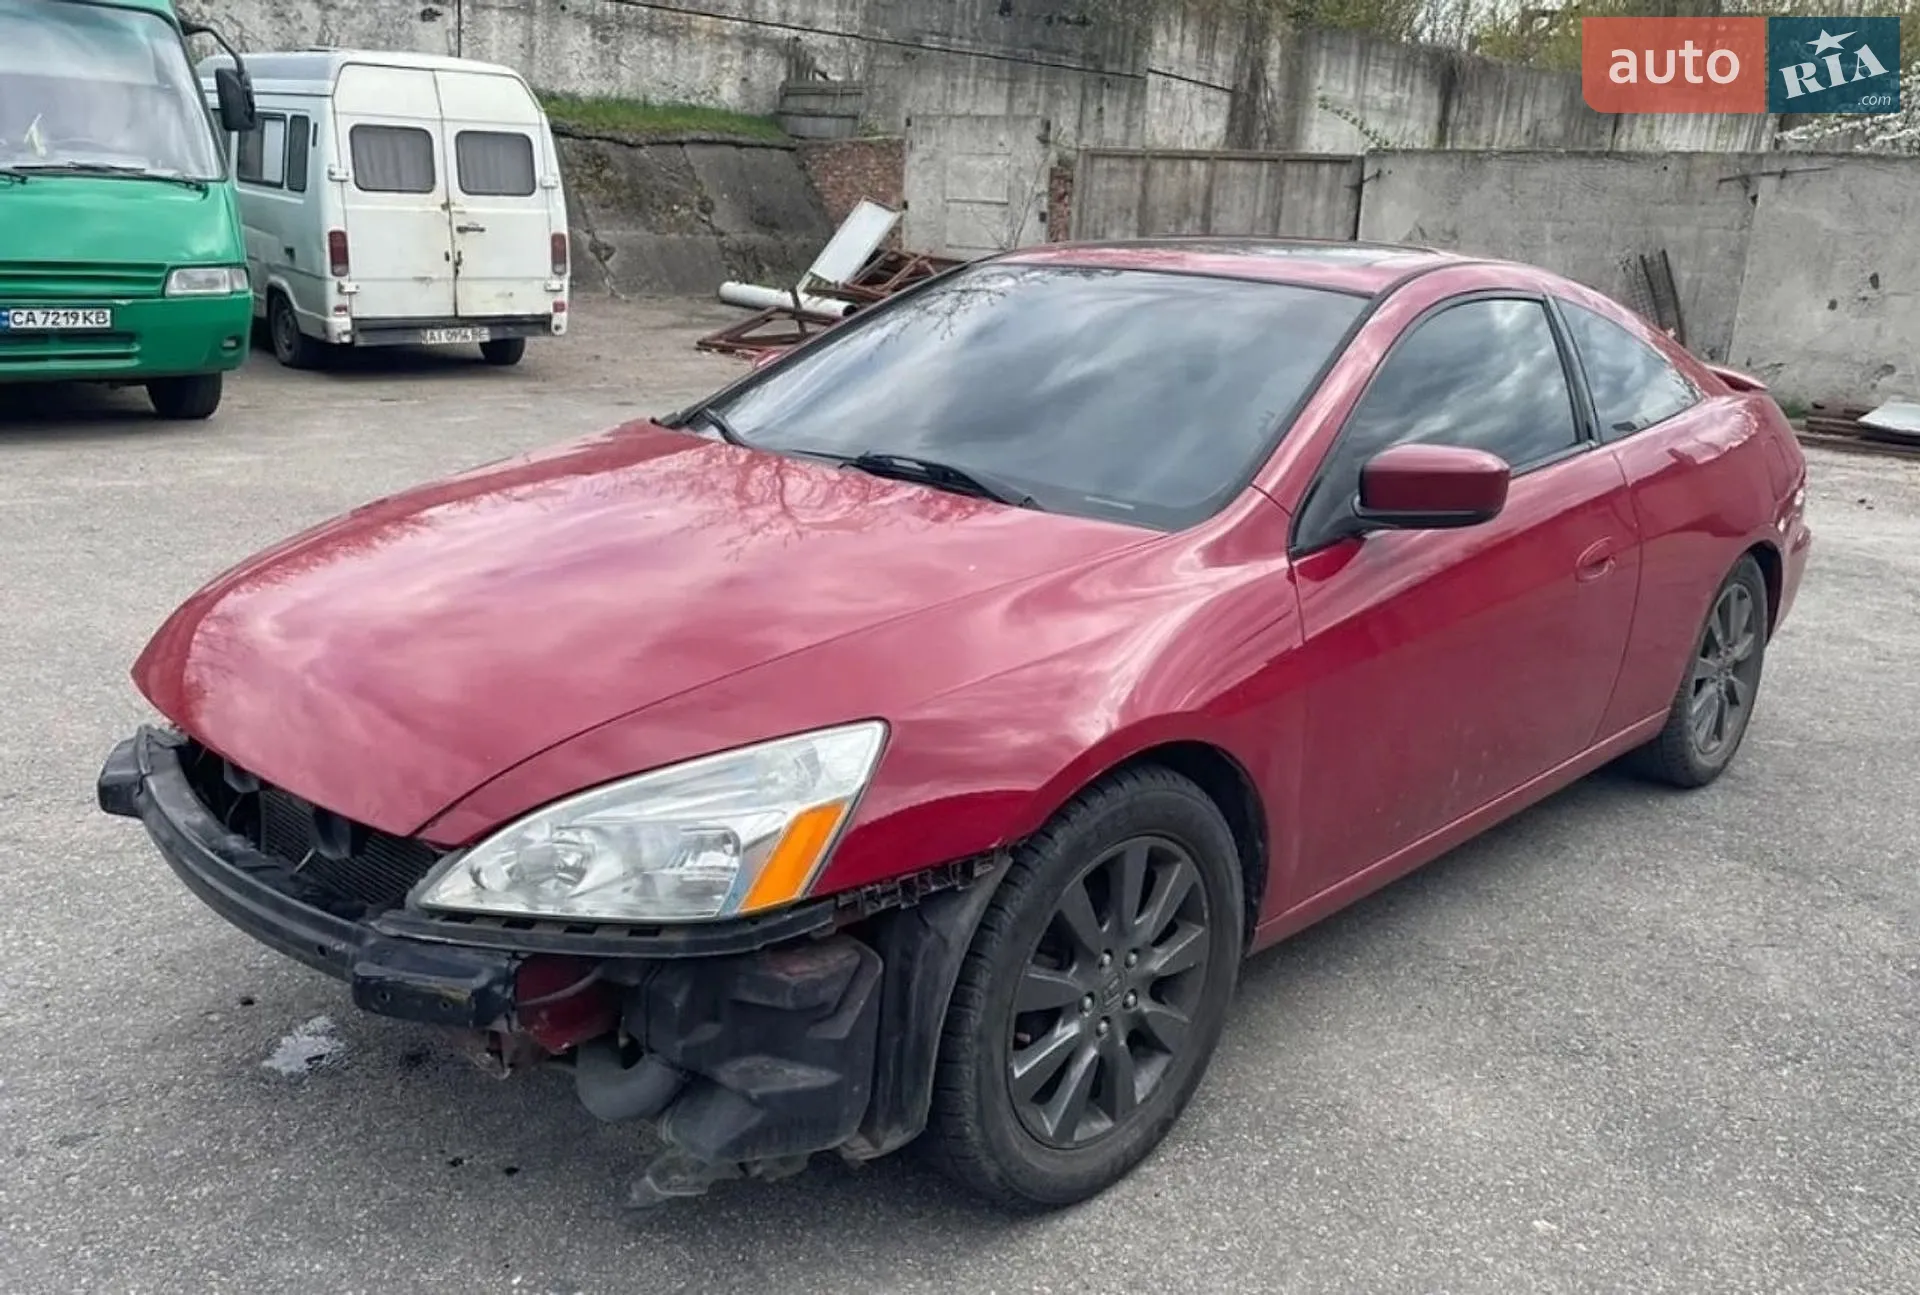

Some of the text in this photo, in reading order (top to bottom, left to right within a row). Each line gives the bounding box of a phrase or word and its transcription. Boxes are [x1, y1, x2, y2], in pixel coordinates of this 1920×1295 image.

[11, 311, 109, 326] CA 7219 KB
